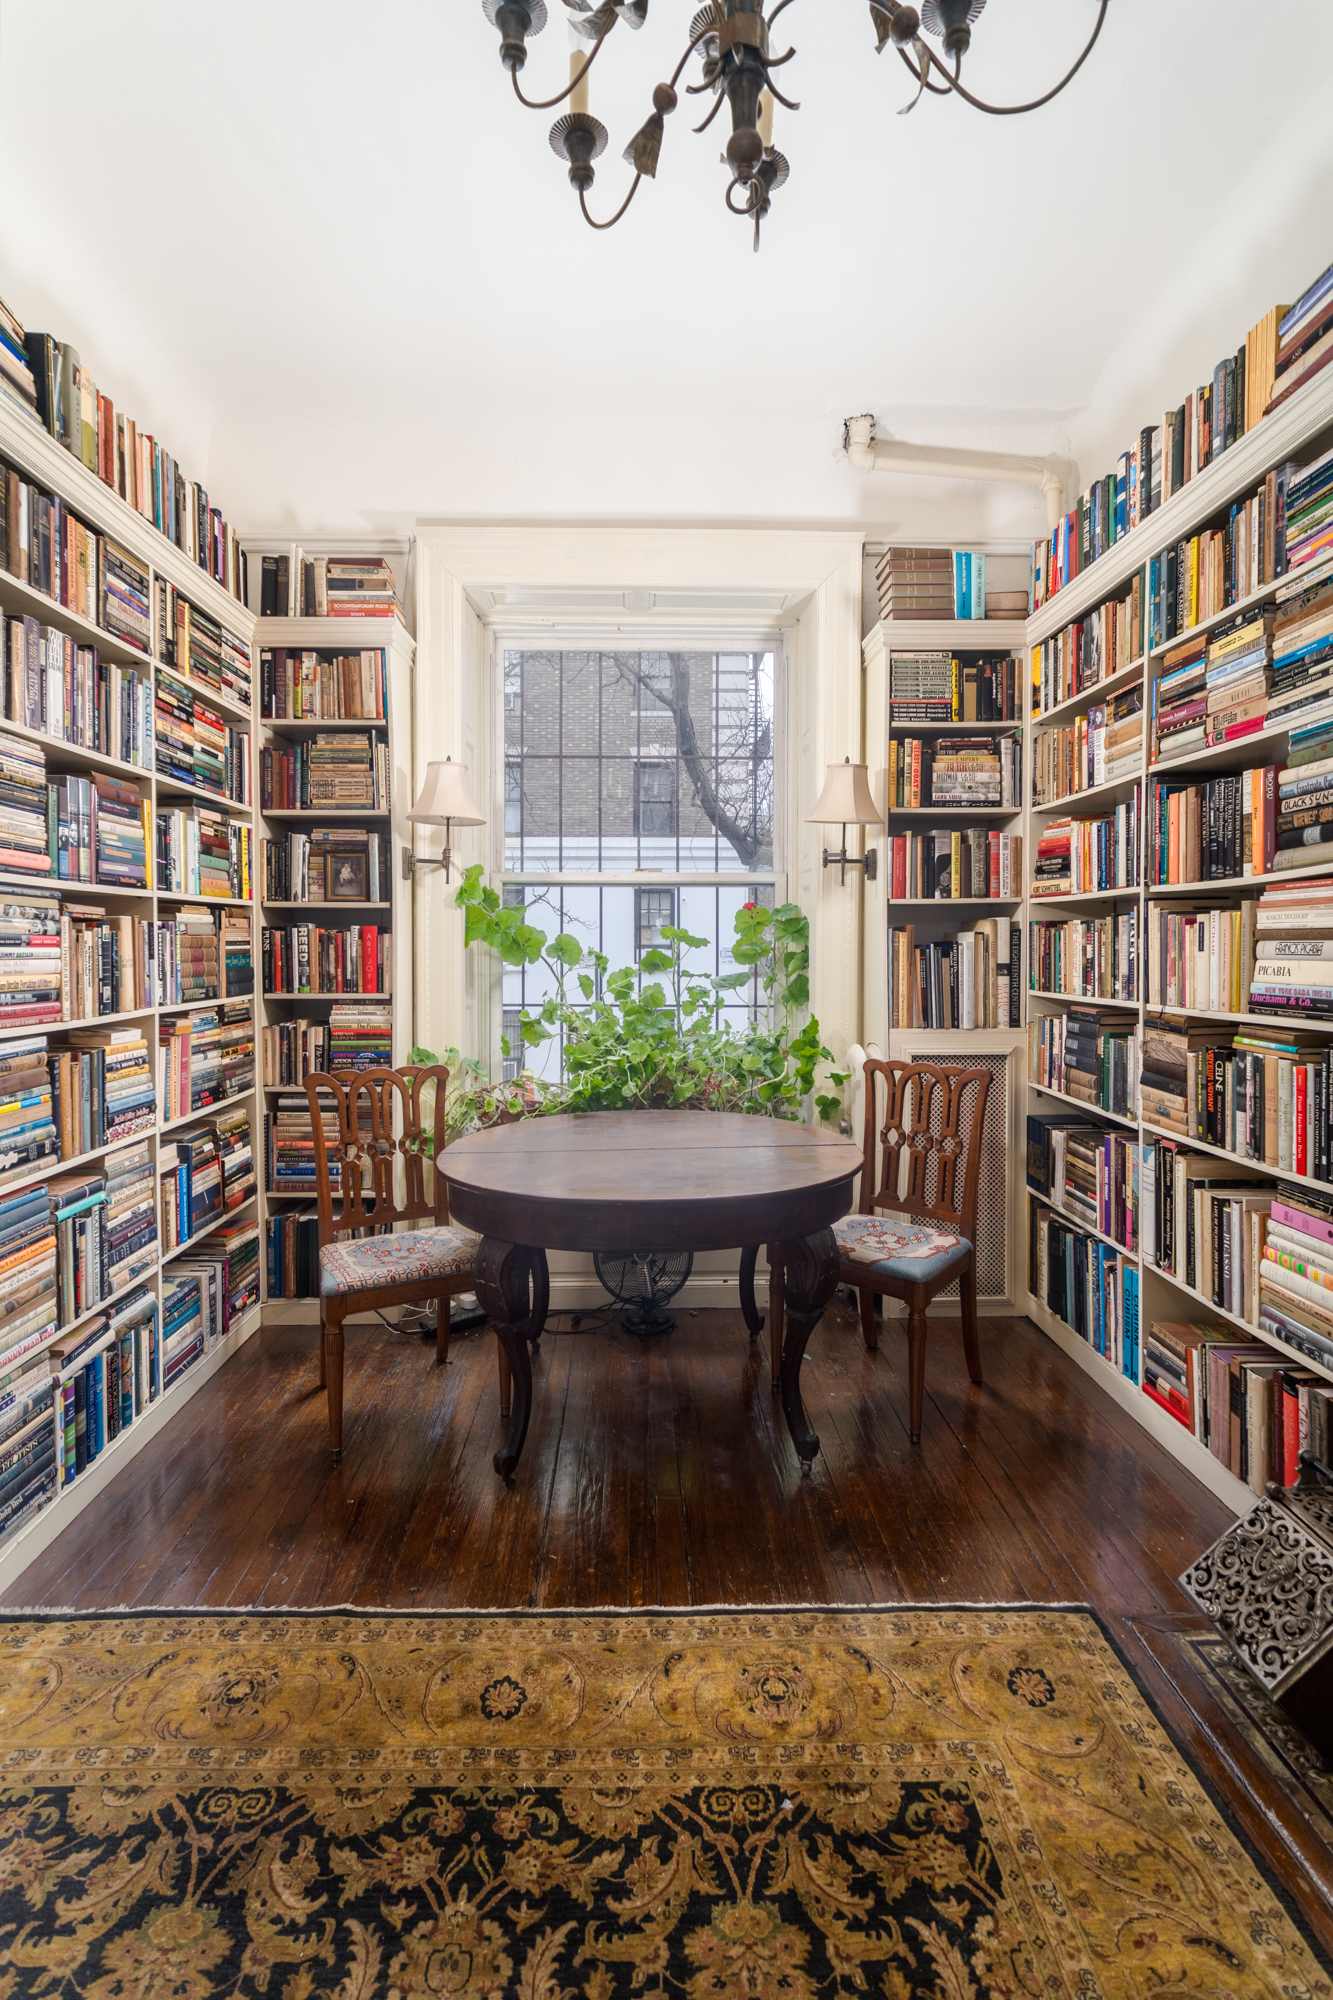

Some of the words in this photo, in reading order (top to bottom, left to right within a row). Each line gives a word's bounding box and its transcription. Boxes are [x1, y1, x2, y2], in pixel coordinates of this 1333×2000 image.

[1160, 715, 1174, 723] Antonin
[1174, 708, 1187, 719] Artaud
[946, 762, 967, 772] BURR
[1284, 794, 1308, 811] BLACK
[1308, 790, 1330, 806] SUN
[974, 836, 985, 859] TOM
[991, 838, 999, 854] BLUE
[974, 860, 985, 889] WOLFE
[991, 875, 999, 893] LAWS
[1284, 912, 1309, 920] DUCHAMP
[298, 927, 309, 962] REED
[1276, 942, 1299, 954] FRANCIS
[1299, 942, 1323, 954] PICABIA
[1258, 965, 1292, 977] PICABIA
[1264, 986, 1277, 994] NEW
[1278, 987, 1292, 995] YORK
[1251, 993, 1287, 1004] Duchamp
[1289, 996, 1297, 1005] &
[1299, 997, 1313, 1006] Co.
[202, 1097, 213, 1106] STICK
[8, 1113, 27, 1124] CAPOTE
[1273, 1225, 1295, 1241] COLOR
[24, 1337, 40, 1354] MAD
[40, 1327, 54, 1341] DOG
